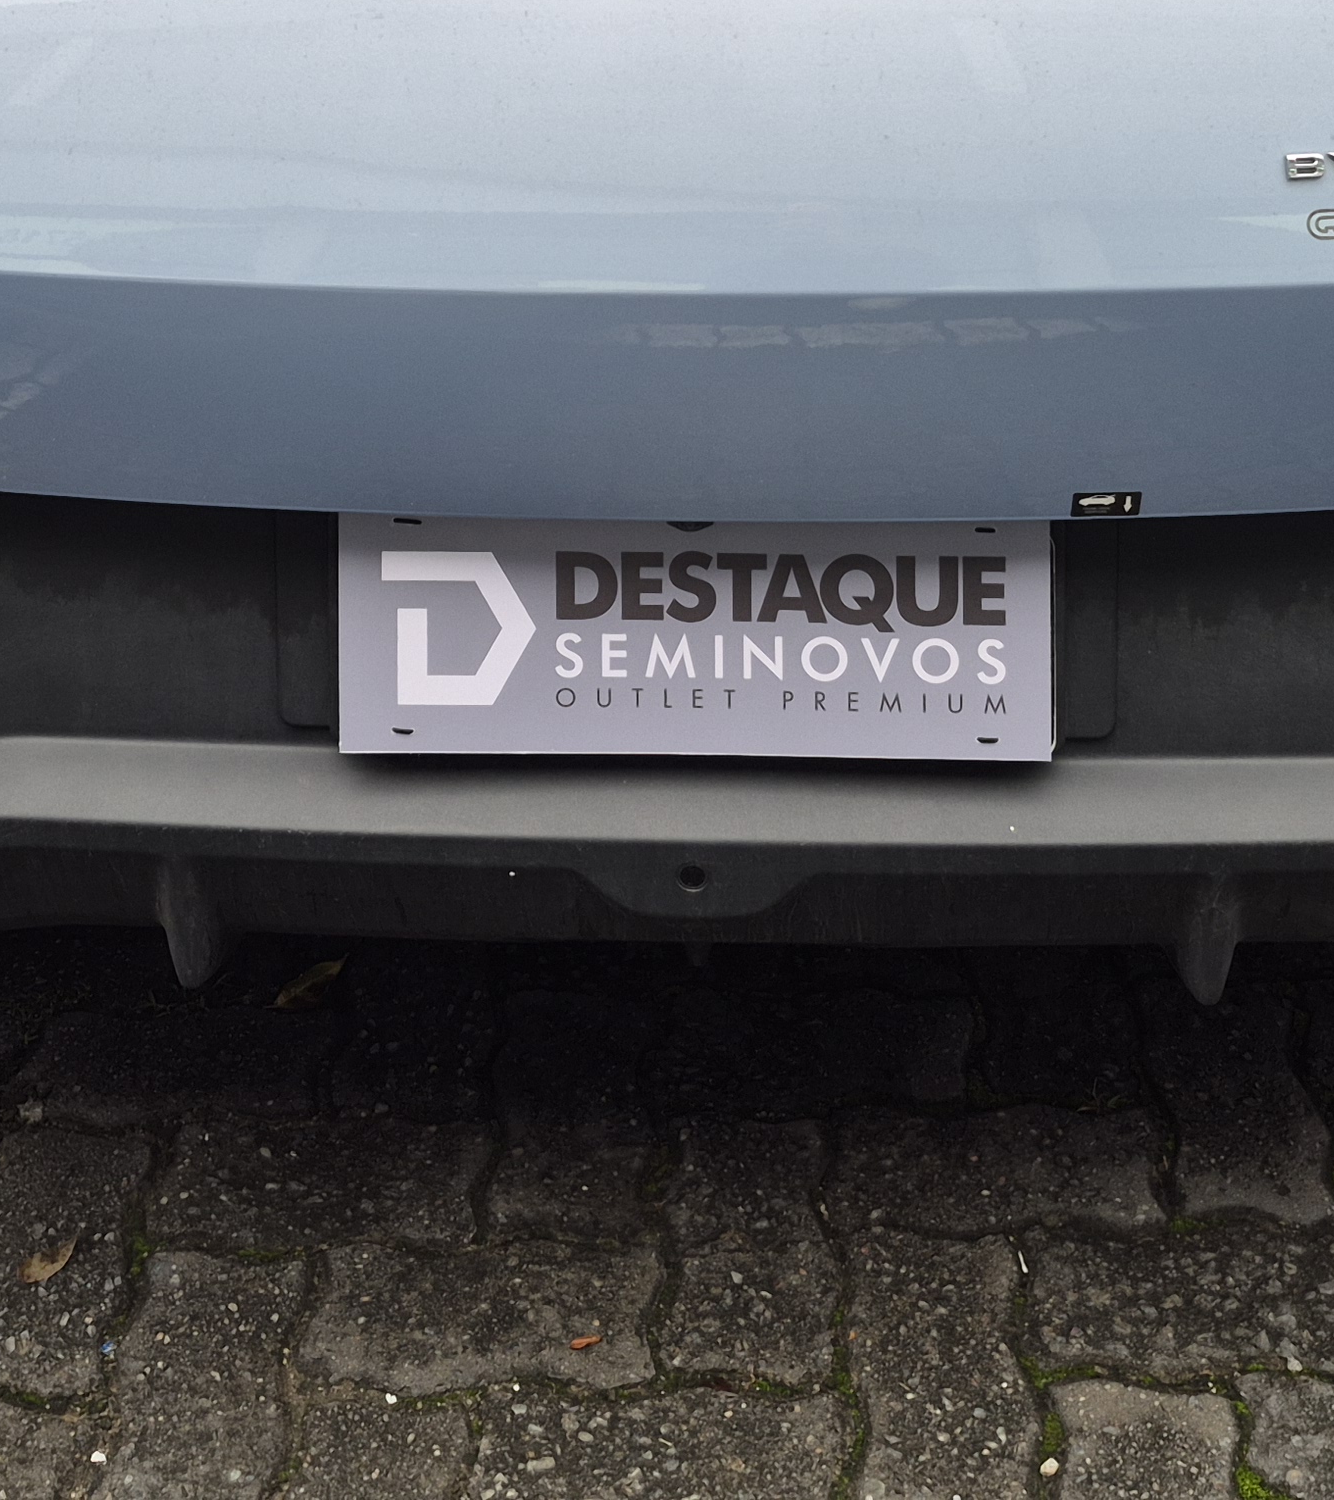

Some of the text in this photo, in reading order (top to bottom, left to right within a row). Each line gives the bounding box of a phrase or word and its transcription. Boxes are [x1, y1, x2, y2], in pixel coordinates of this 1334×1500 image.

[555, 550, 1007, 633] DESTAQUE
[554, 632, 1008, 686] SEMINOVOS
[554, 687, 1008, 716] OUTLET PREMIUM
